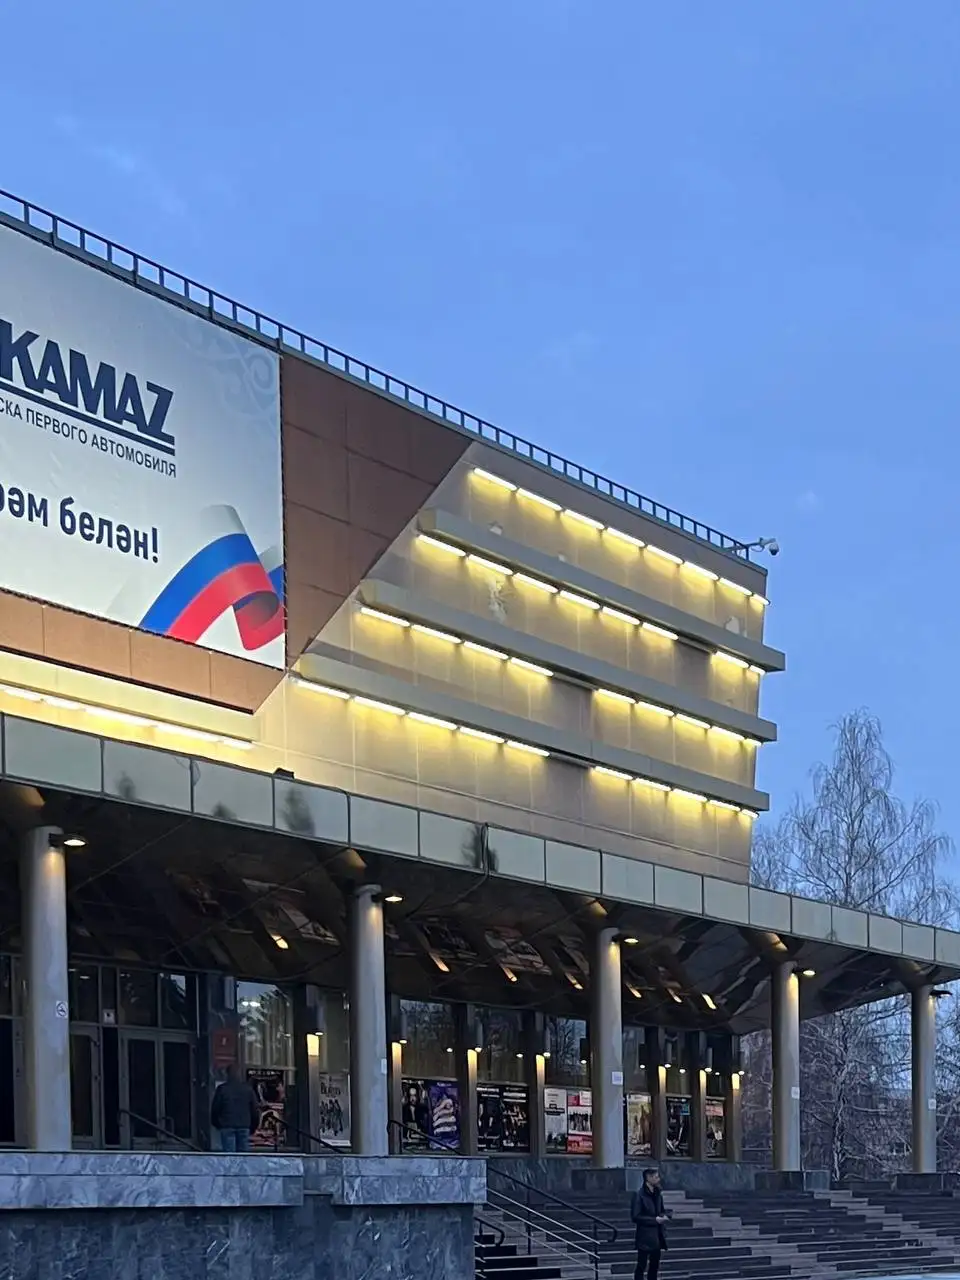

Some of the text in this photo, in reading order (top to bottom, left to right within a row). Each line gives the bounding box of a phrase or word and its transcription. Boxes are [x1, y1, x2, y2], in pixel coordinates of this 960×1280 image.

[0, 318, 175, 446] KAMAZ
[26, 408, 87, 444] ПЕРВОГО
[91, 434, 177, 478] АВТОМОБИЛЯ
[0, 483, 159, 563] әм белән!
